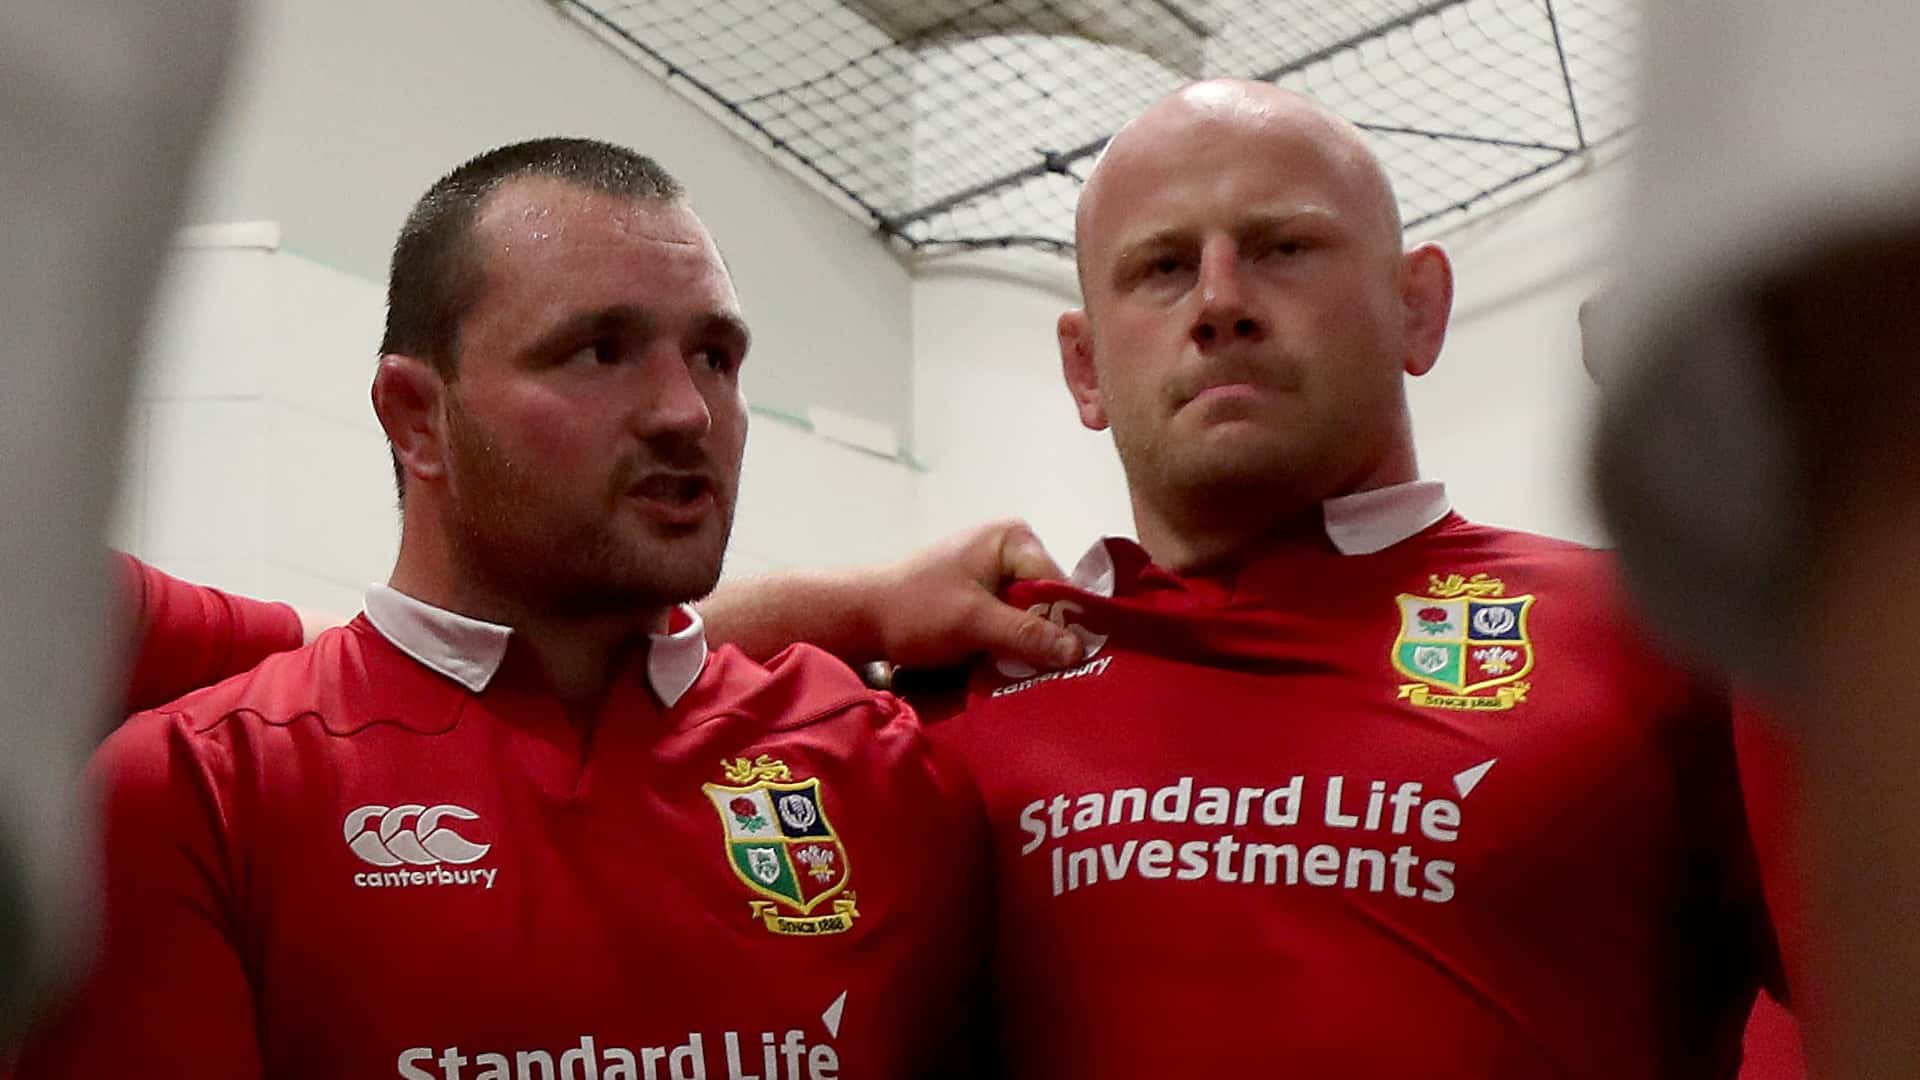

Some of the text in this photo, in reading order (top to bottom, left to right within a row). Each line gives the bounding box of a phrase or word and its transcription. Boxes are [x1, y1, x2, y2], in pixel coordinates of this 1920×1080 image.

[1020, 776, 1462, 855] Standard Life
[353, 864, 498, 889] canterbury
[1052, 835, 1456, 903] Investments
[397, 1030, 839, 1080] Standard Life
